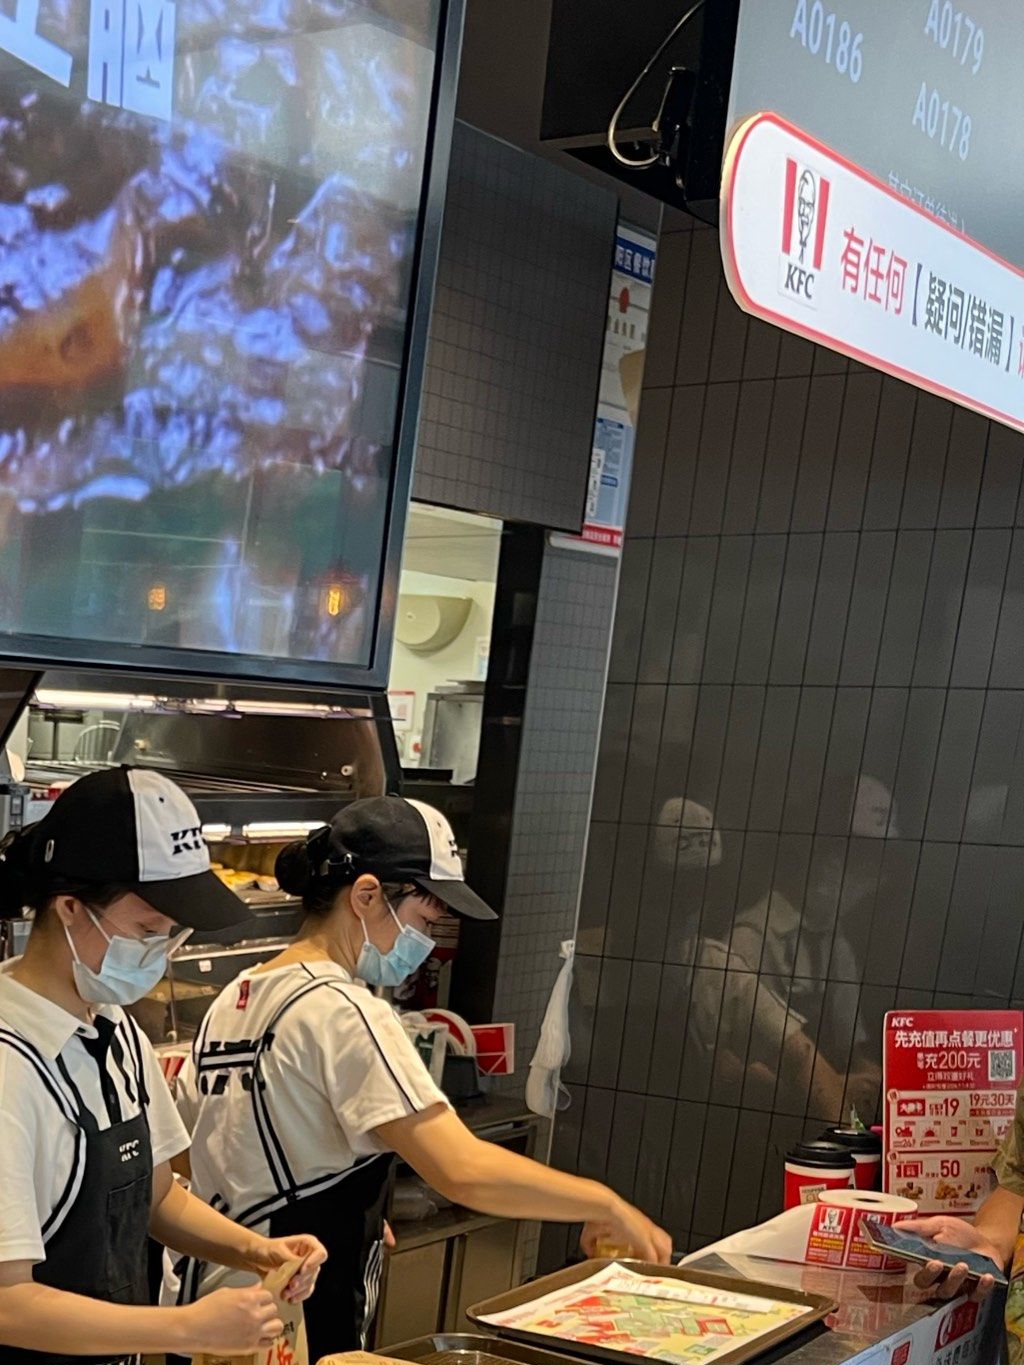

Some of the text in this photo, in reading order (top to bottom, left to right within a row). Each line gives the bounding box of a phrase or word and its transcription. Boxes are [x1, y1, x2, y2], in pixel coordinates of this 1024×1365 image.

[789, 0, 864, 83] A0186
[924, 0, 985, 76] A0179
[912, 82, 972, 161] A0178
[784, 264, 815, 300] KFC
[891, 1017, 914, 1027] KFC
[940, 1160, 960, 1178] 50
